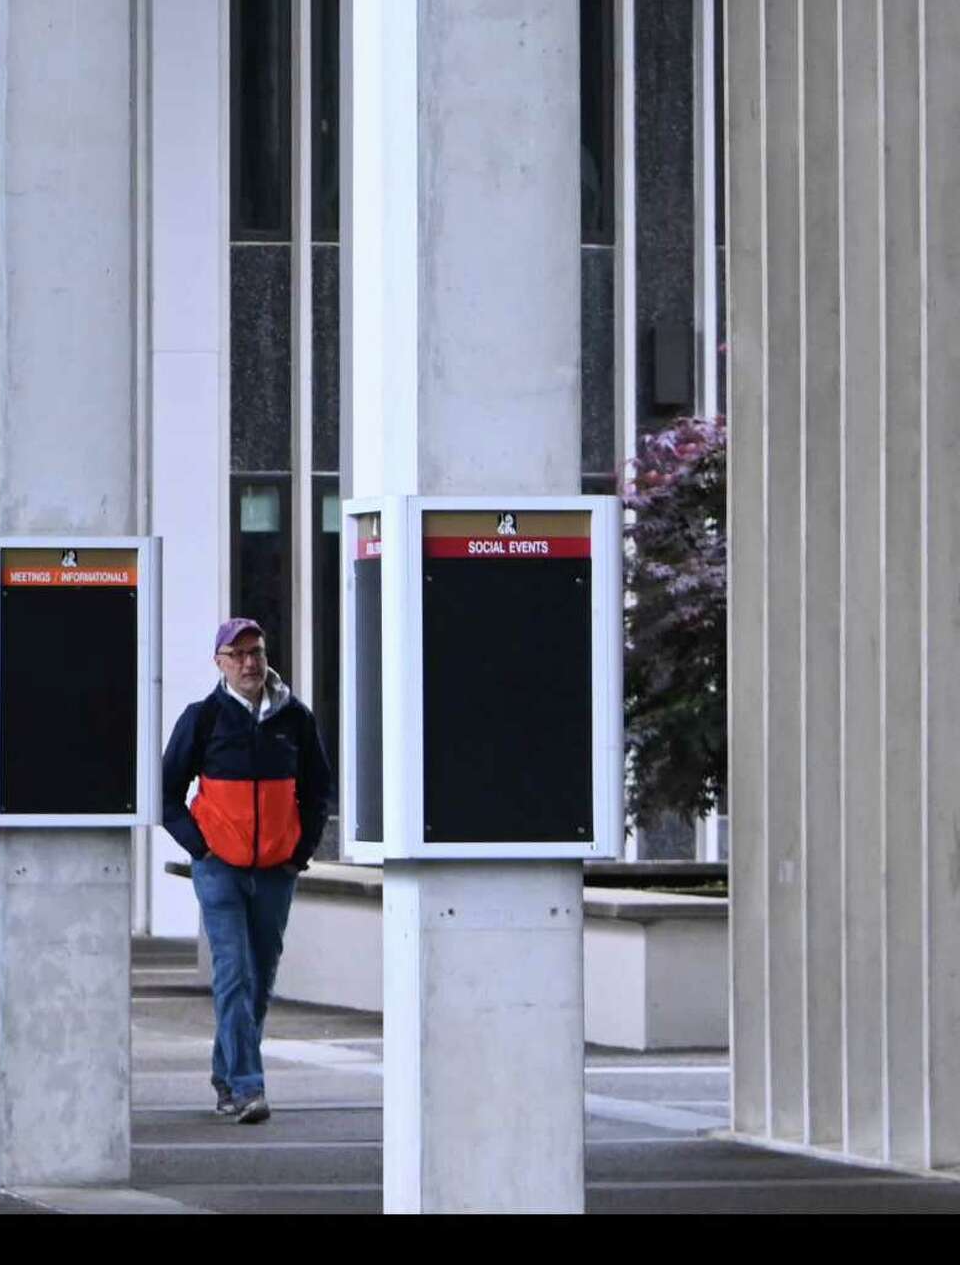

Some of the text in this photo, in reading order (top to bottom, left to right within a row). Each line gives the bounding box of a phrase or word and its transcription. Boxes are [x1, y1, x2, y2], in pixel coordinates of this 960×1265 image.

[468, 541, 548, 554] SOCIAL EVENTS
[10, 571, 50, 583] MEETINGS
[61, 571, 128, 583] INFORMATIONALS
